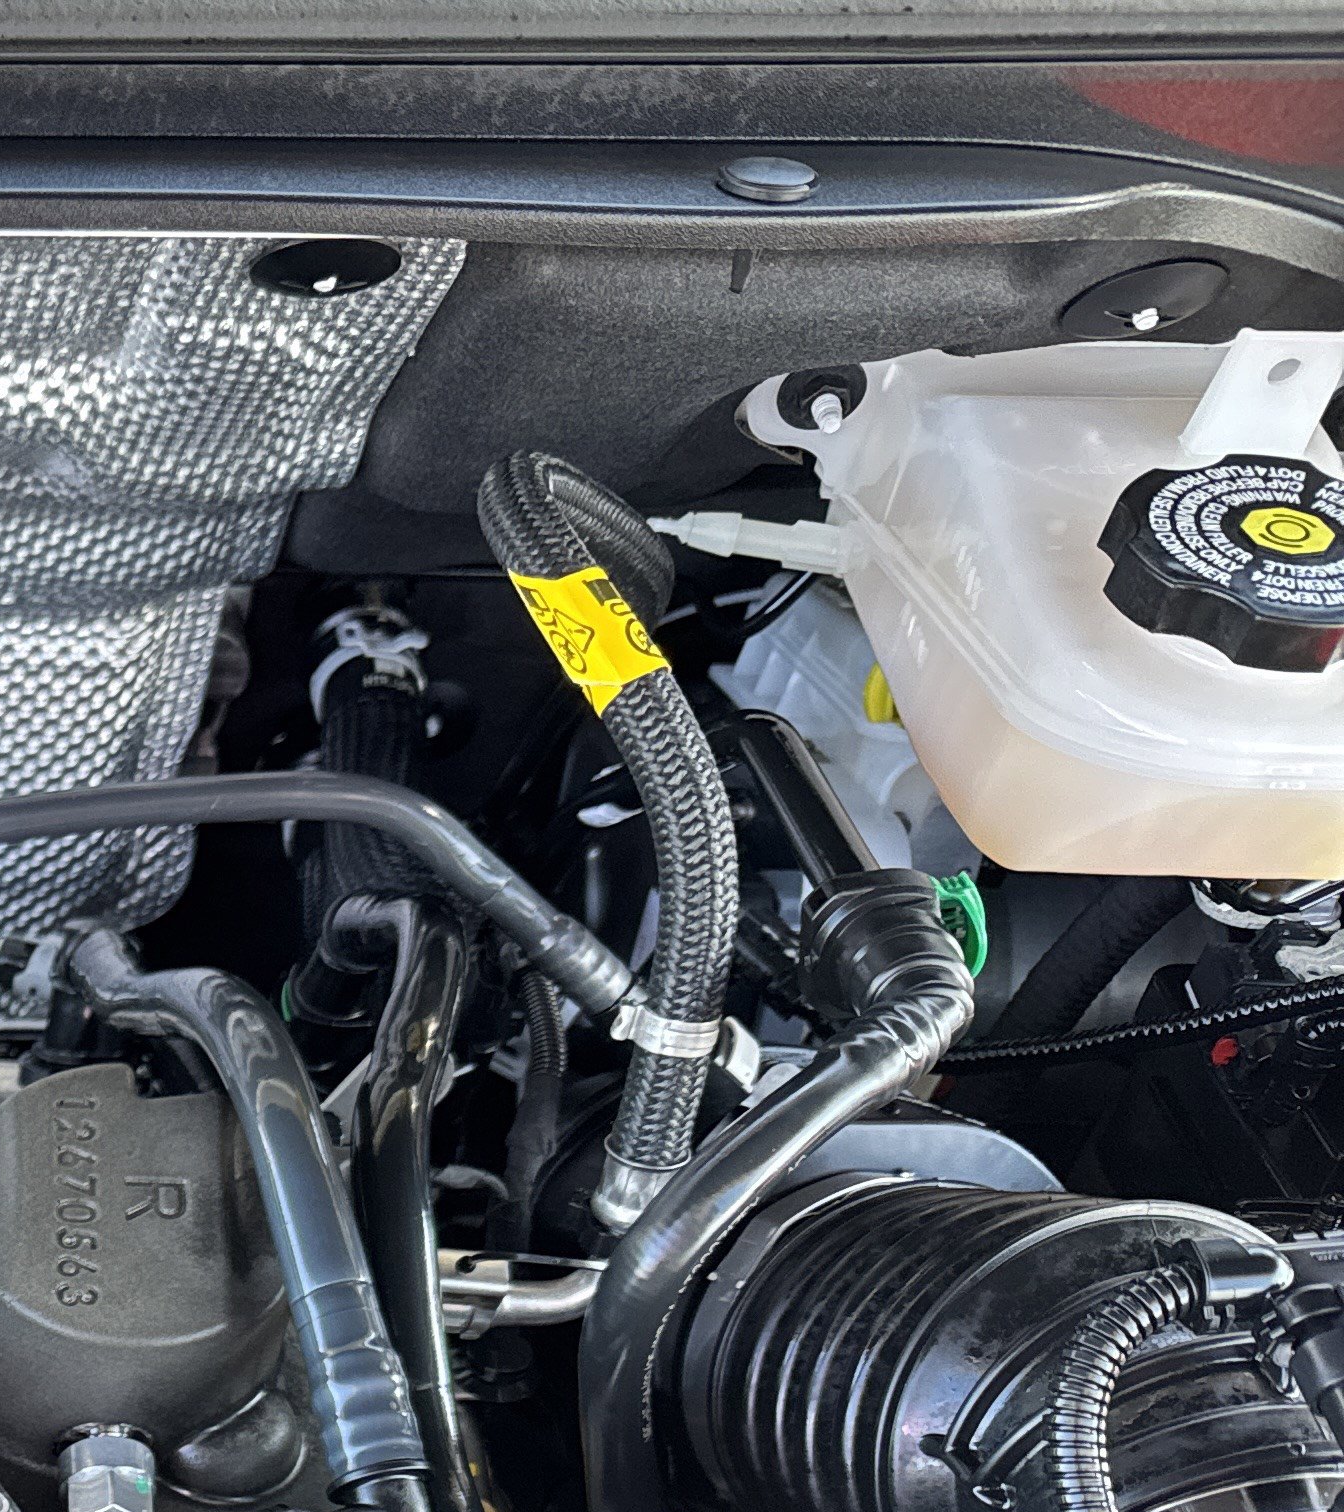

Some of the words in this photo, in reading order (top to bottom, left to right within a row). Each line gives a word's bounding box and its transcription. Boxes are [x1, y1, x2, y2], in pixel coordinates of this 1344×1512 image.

[1205, 465, 1256, 480] FLUID
[1254, 465, 1268, 477] 4
[1267, 466, 1307, 481] DOT
[1164, 472, 1211, 496] FROM
[1201, 478, 1266, 497] BEFORE
[1266, 479, 1305, 493] CAP
[1149, 496, 1175, 532] SEALED
[1200, 502, 1229, 532] CLEAN
[1199, 548, 1245, 572] ONLY
[1204, 532, 1254, 564] FILLER
[1261, 574, 1296, 589] DOT
[54, 1098, 99, 1307] 12670563
[124, 1175, 190, 1221] R
